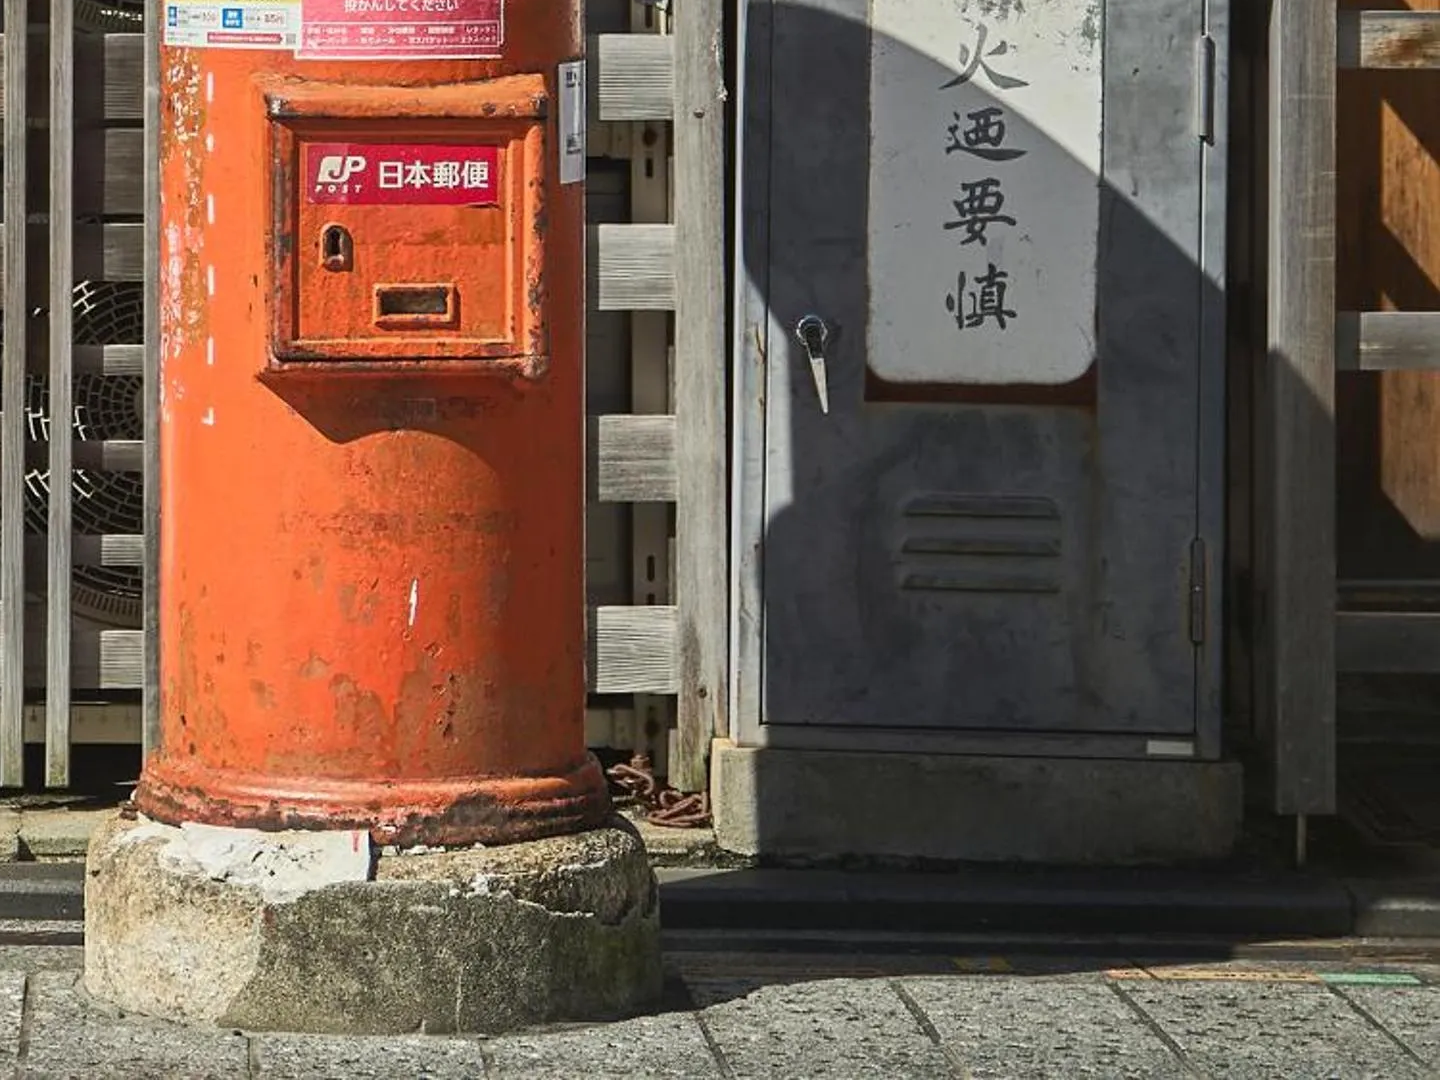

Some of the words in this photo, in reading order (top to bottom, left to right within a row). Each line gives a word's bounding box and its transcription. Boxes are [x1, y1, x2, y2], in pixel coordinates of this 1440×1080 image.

[343, 0, 460, 12] 投かんしてください
[317, 155, 368, 183] JP
[378, 160, 490, 189] 日本郵便
[314, 184, 363, 194] POST
